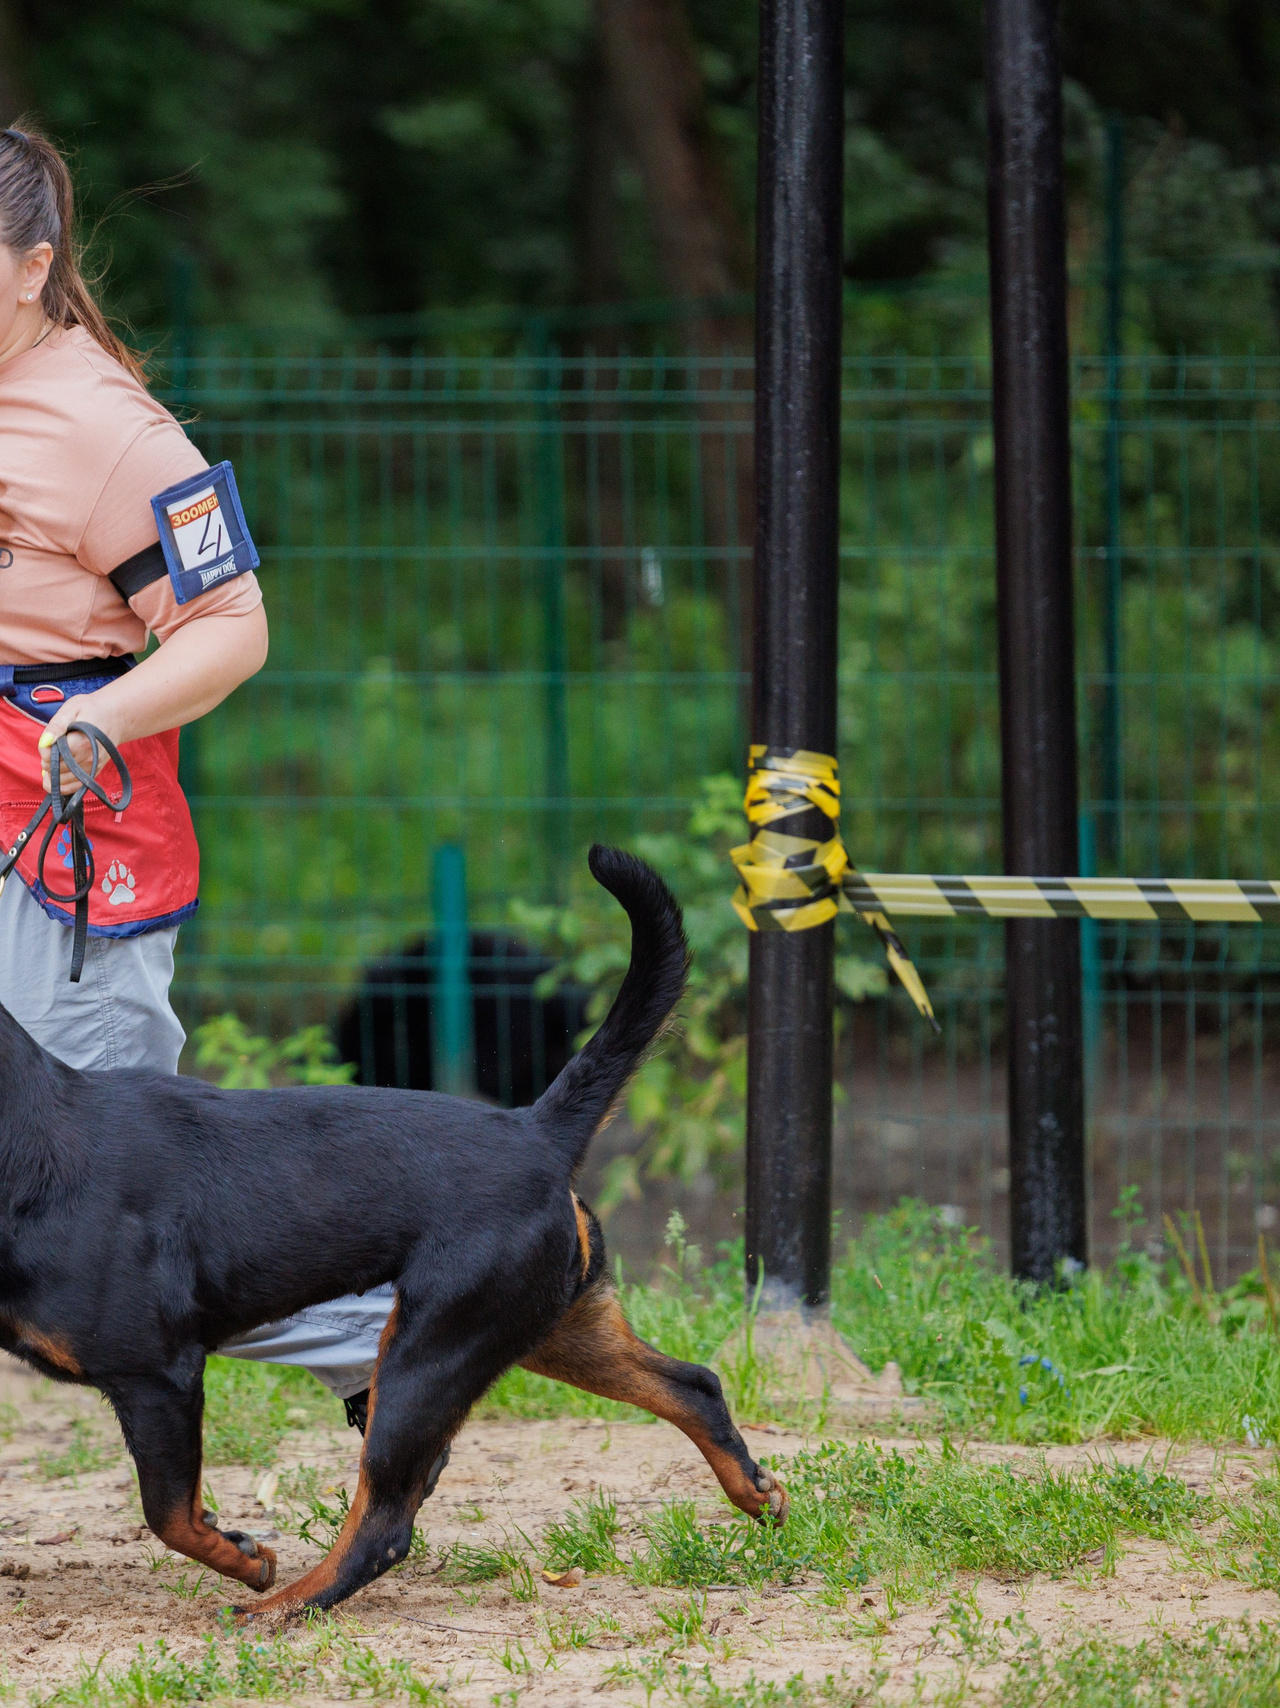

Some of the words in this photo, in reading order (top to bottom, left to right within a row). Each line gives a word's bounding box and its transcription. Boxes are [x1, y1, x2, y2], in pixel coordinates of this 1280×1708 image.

[197, 510, 222, 558] 4
[200, 566, 222, 586] HAPPY
[223, 559, 236, 574] DOG
